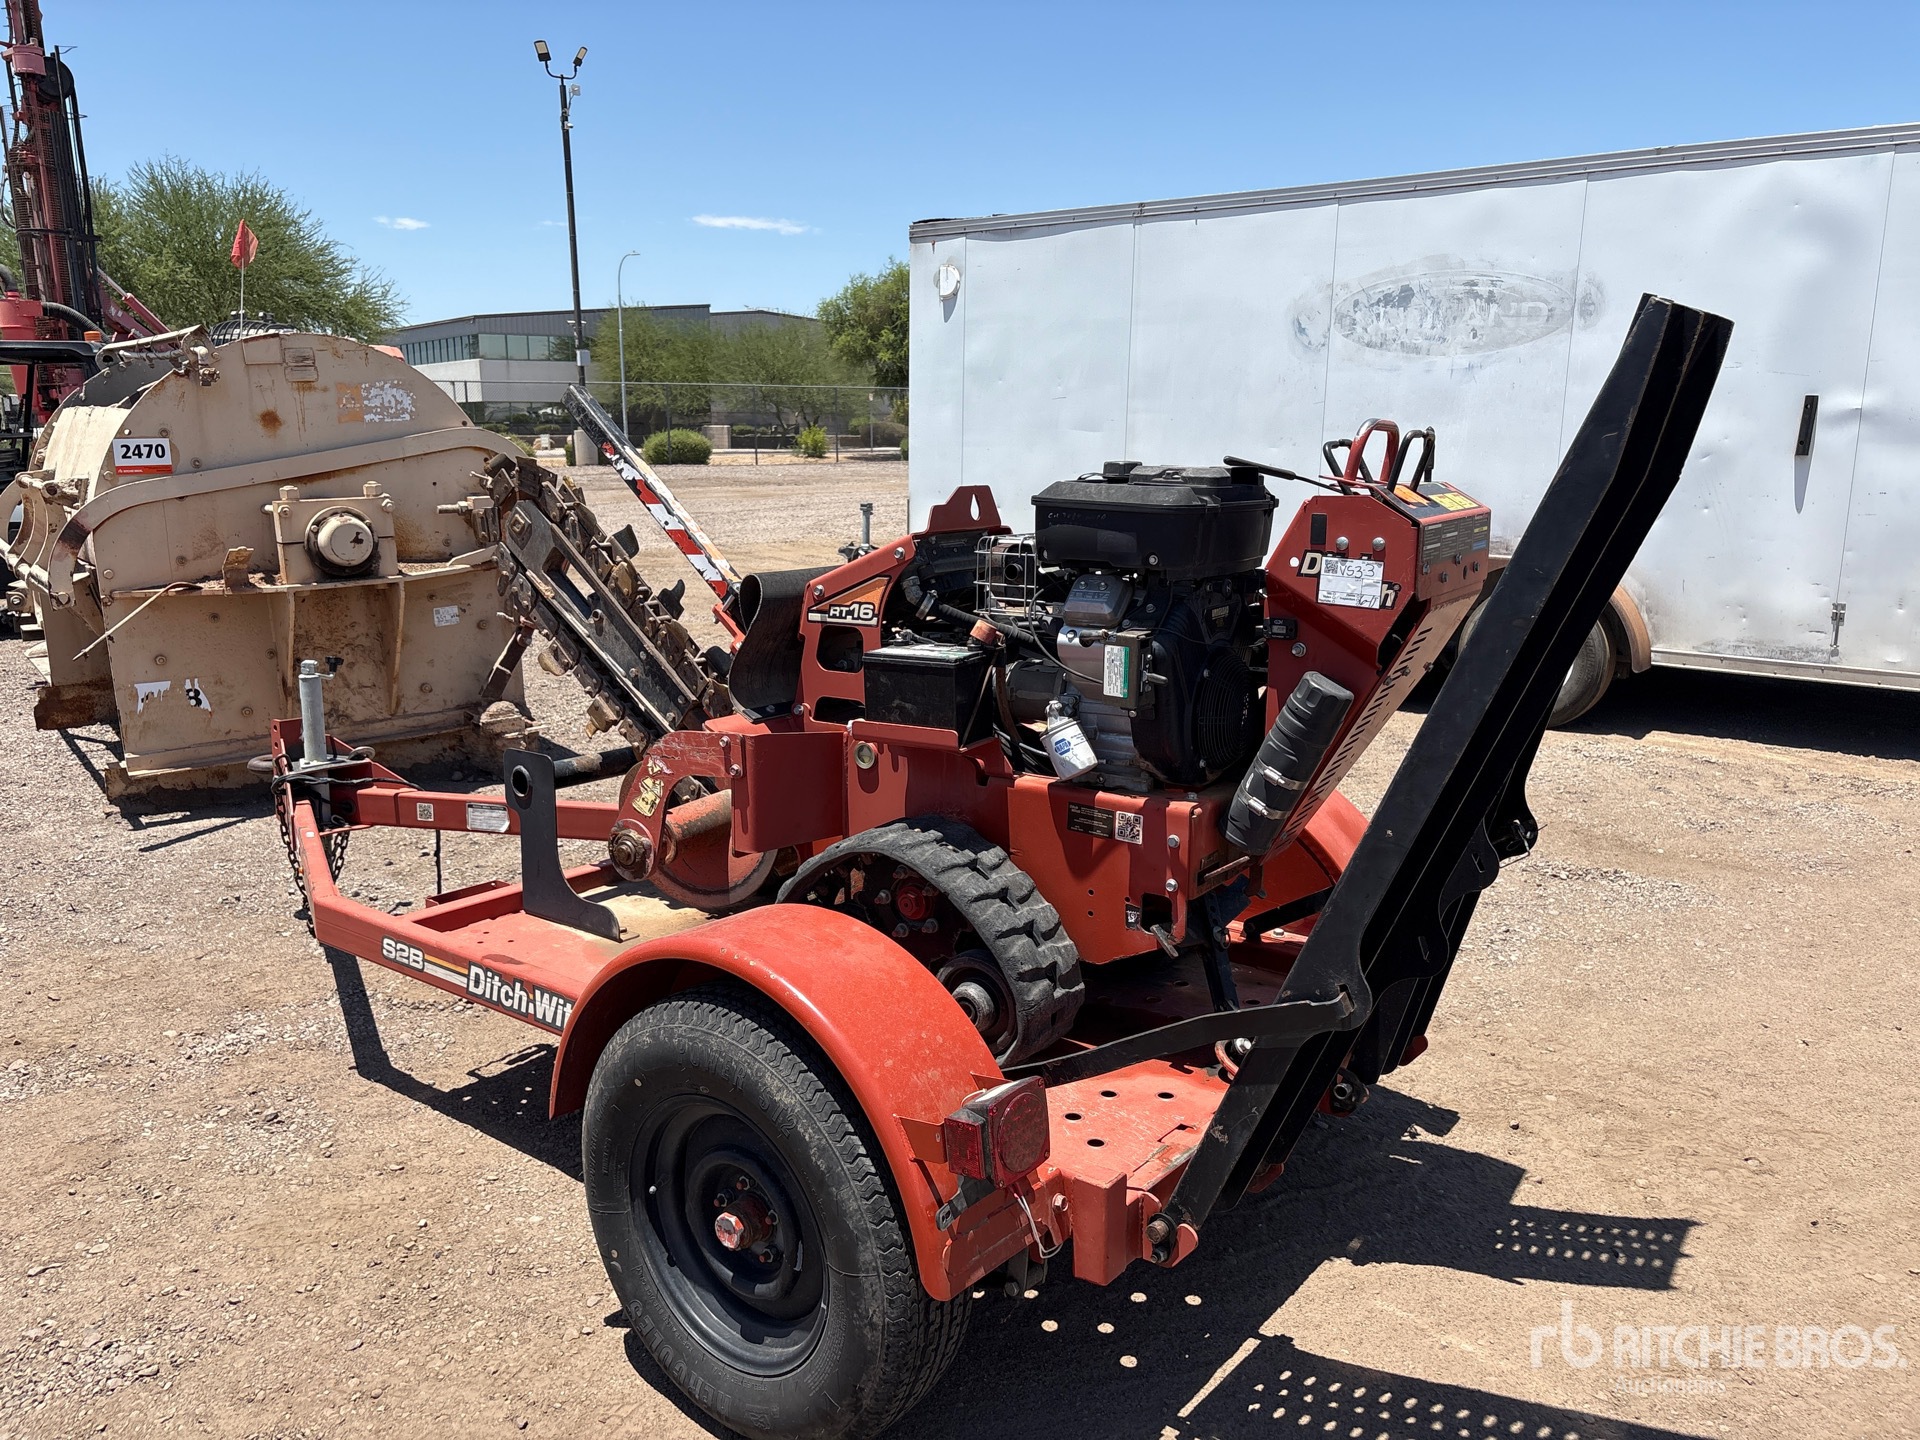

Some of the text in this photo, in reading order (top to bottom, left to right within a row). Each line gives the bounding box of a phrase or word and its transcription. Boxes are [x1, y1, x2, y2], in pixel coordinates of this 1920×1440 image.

[120, 443, 166, 459] 2470
[829, 603, 874, 619] RT16
[382, 937, 424, 970] S2B
[468, 963, 529, 1014] Ditch
